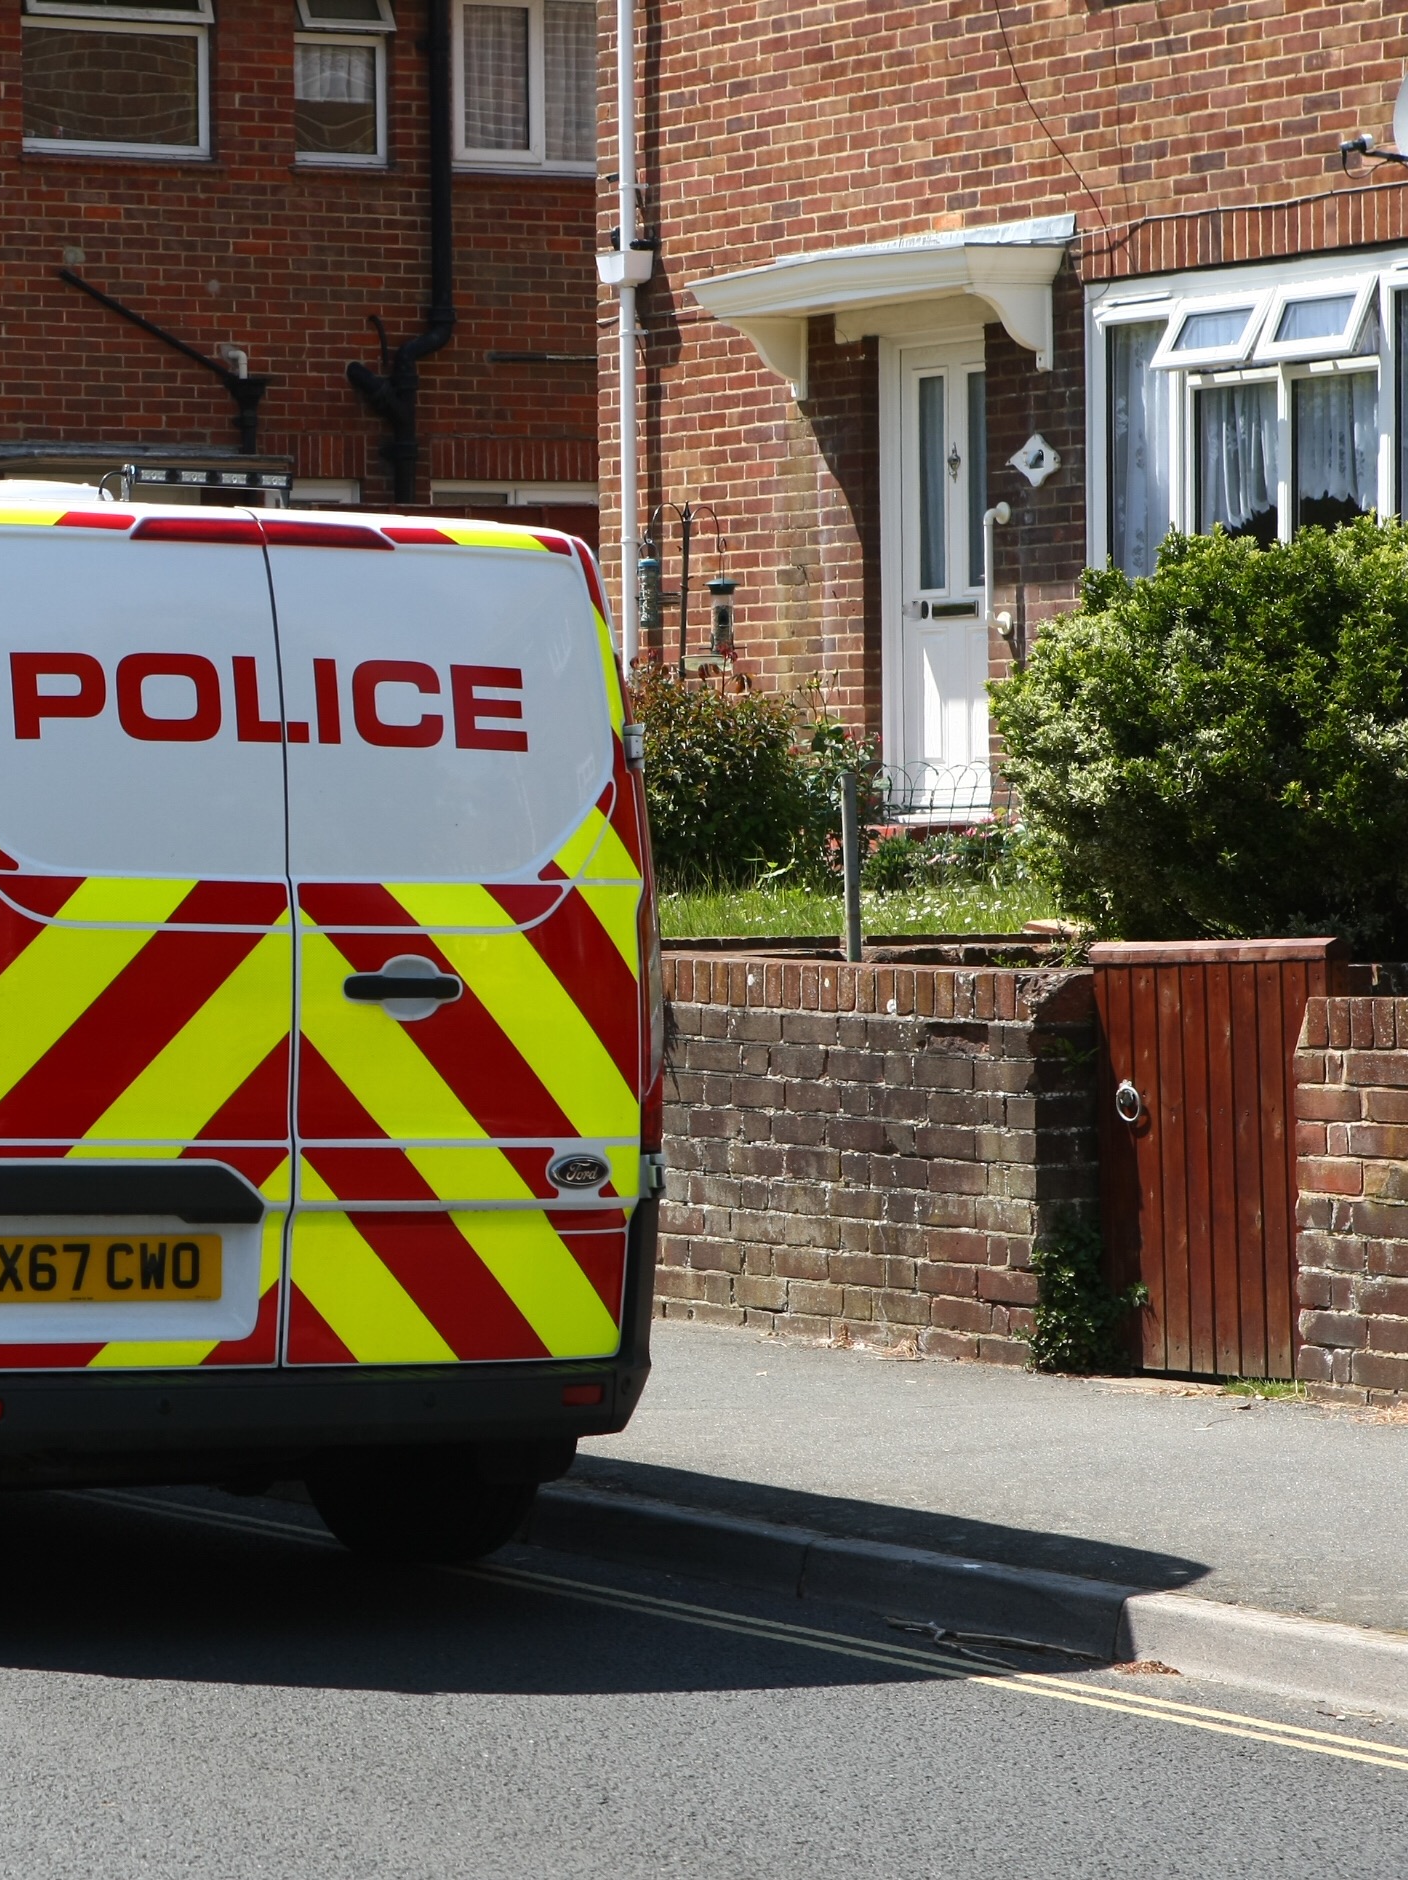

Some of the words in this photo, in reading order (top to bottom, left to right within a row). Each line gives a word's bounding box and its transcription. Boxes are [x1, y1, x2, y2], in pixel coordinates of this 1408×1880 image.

[9, 652, 529, 752] POLICE
[566, 1162, 599, 1181] Ford
[106, 1242, 200, 1290] CWO
